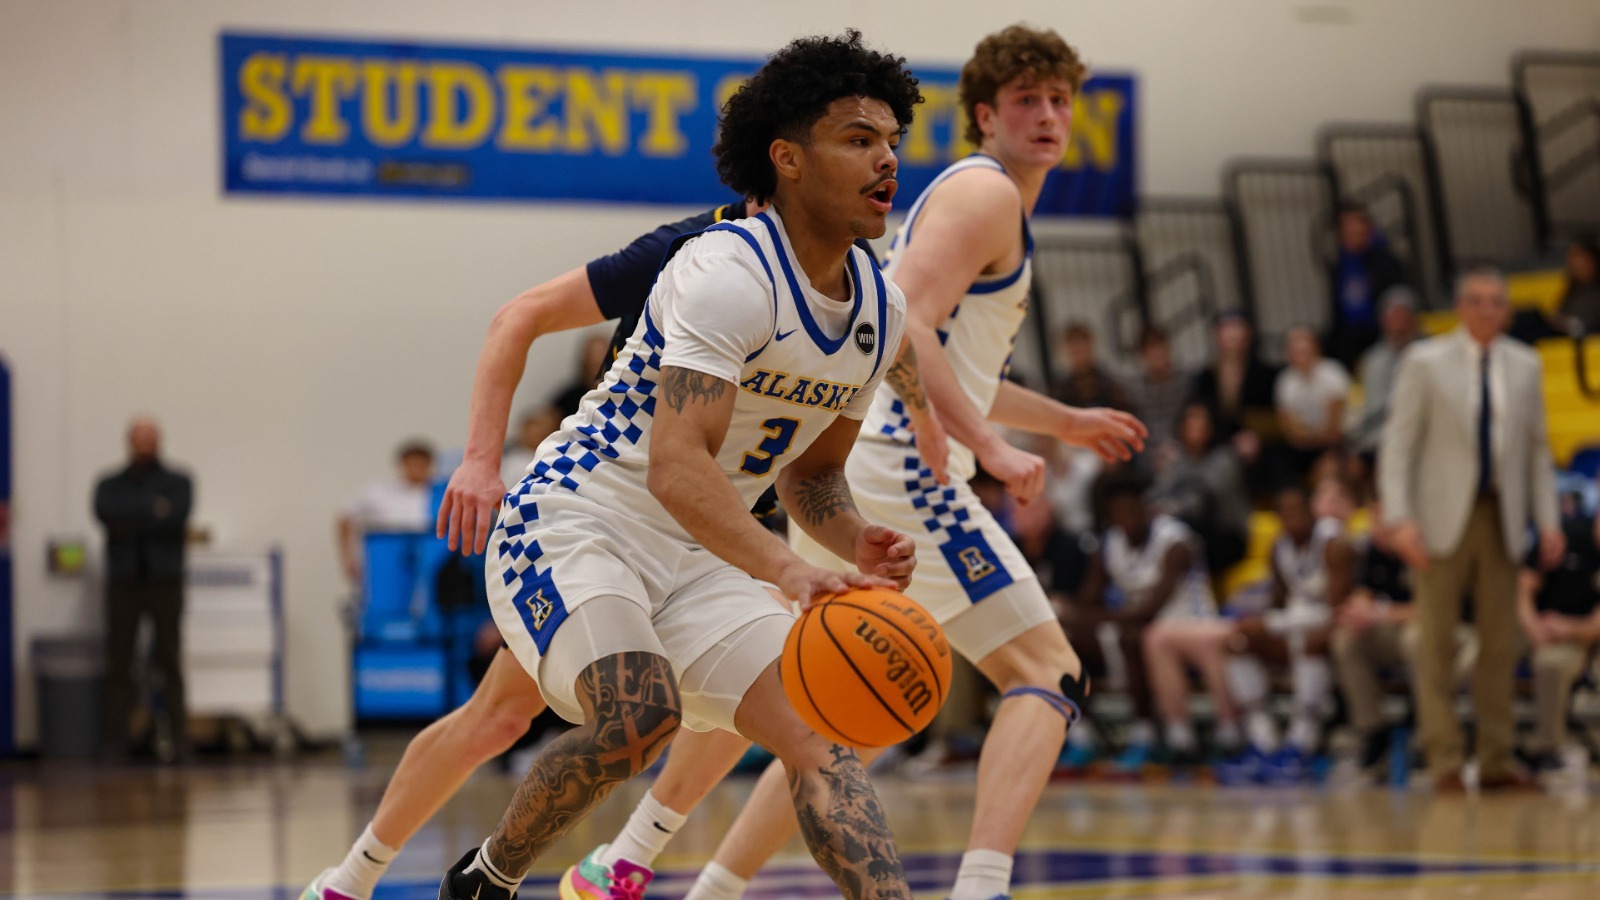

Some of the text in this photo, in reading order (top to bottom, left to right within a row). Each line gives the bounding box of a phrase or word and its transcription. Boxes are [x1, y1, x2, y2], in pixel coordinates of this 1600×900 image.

[239, 52, 698, 157] STUDENT
[857, 332, 874, 345] WIN
[738, 415, 802, 479] 3
[854, 620, 932, 717] Wilson
